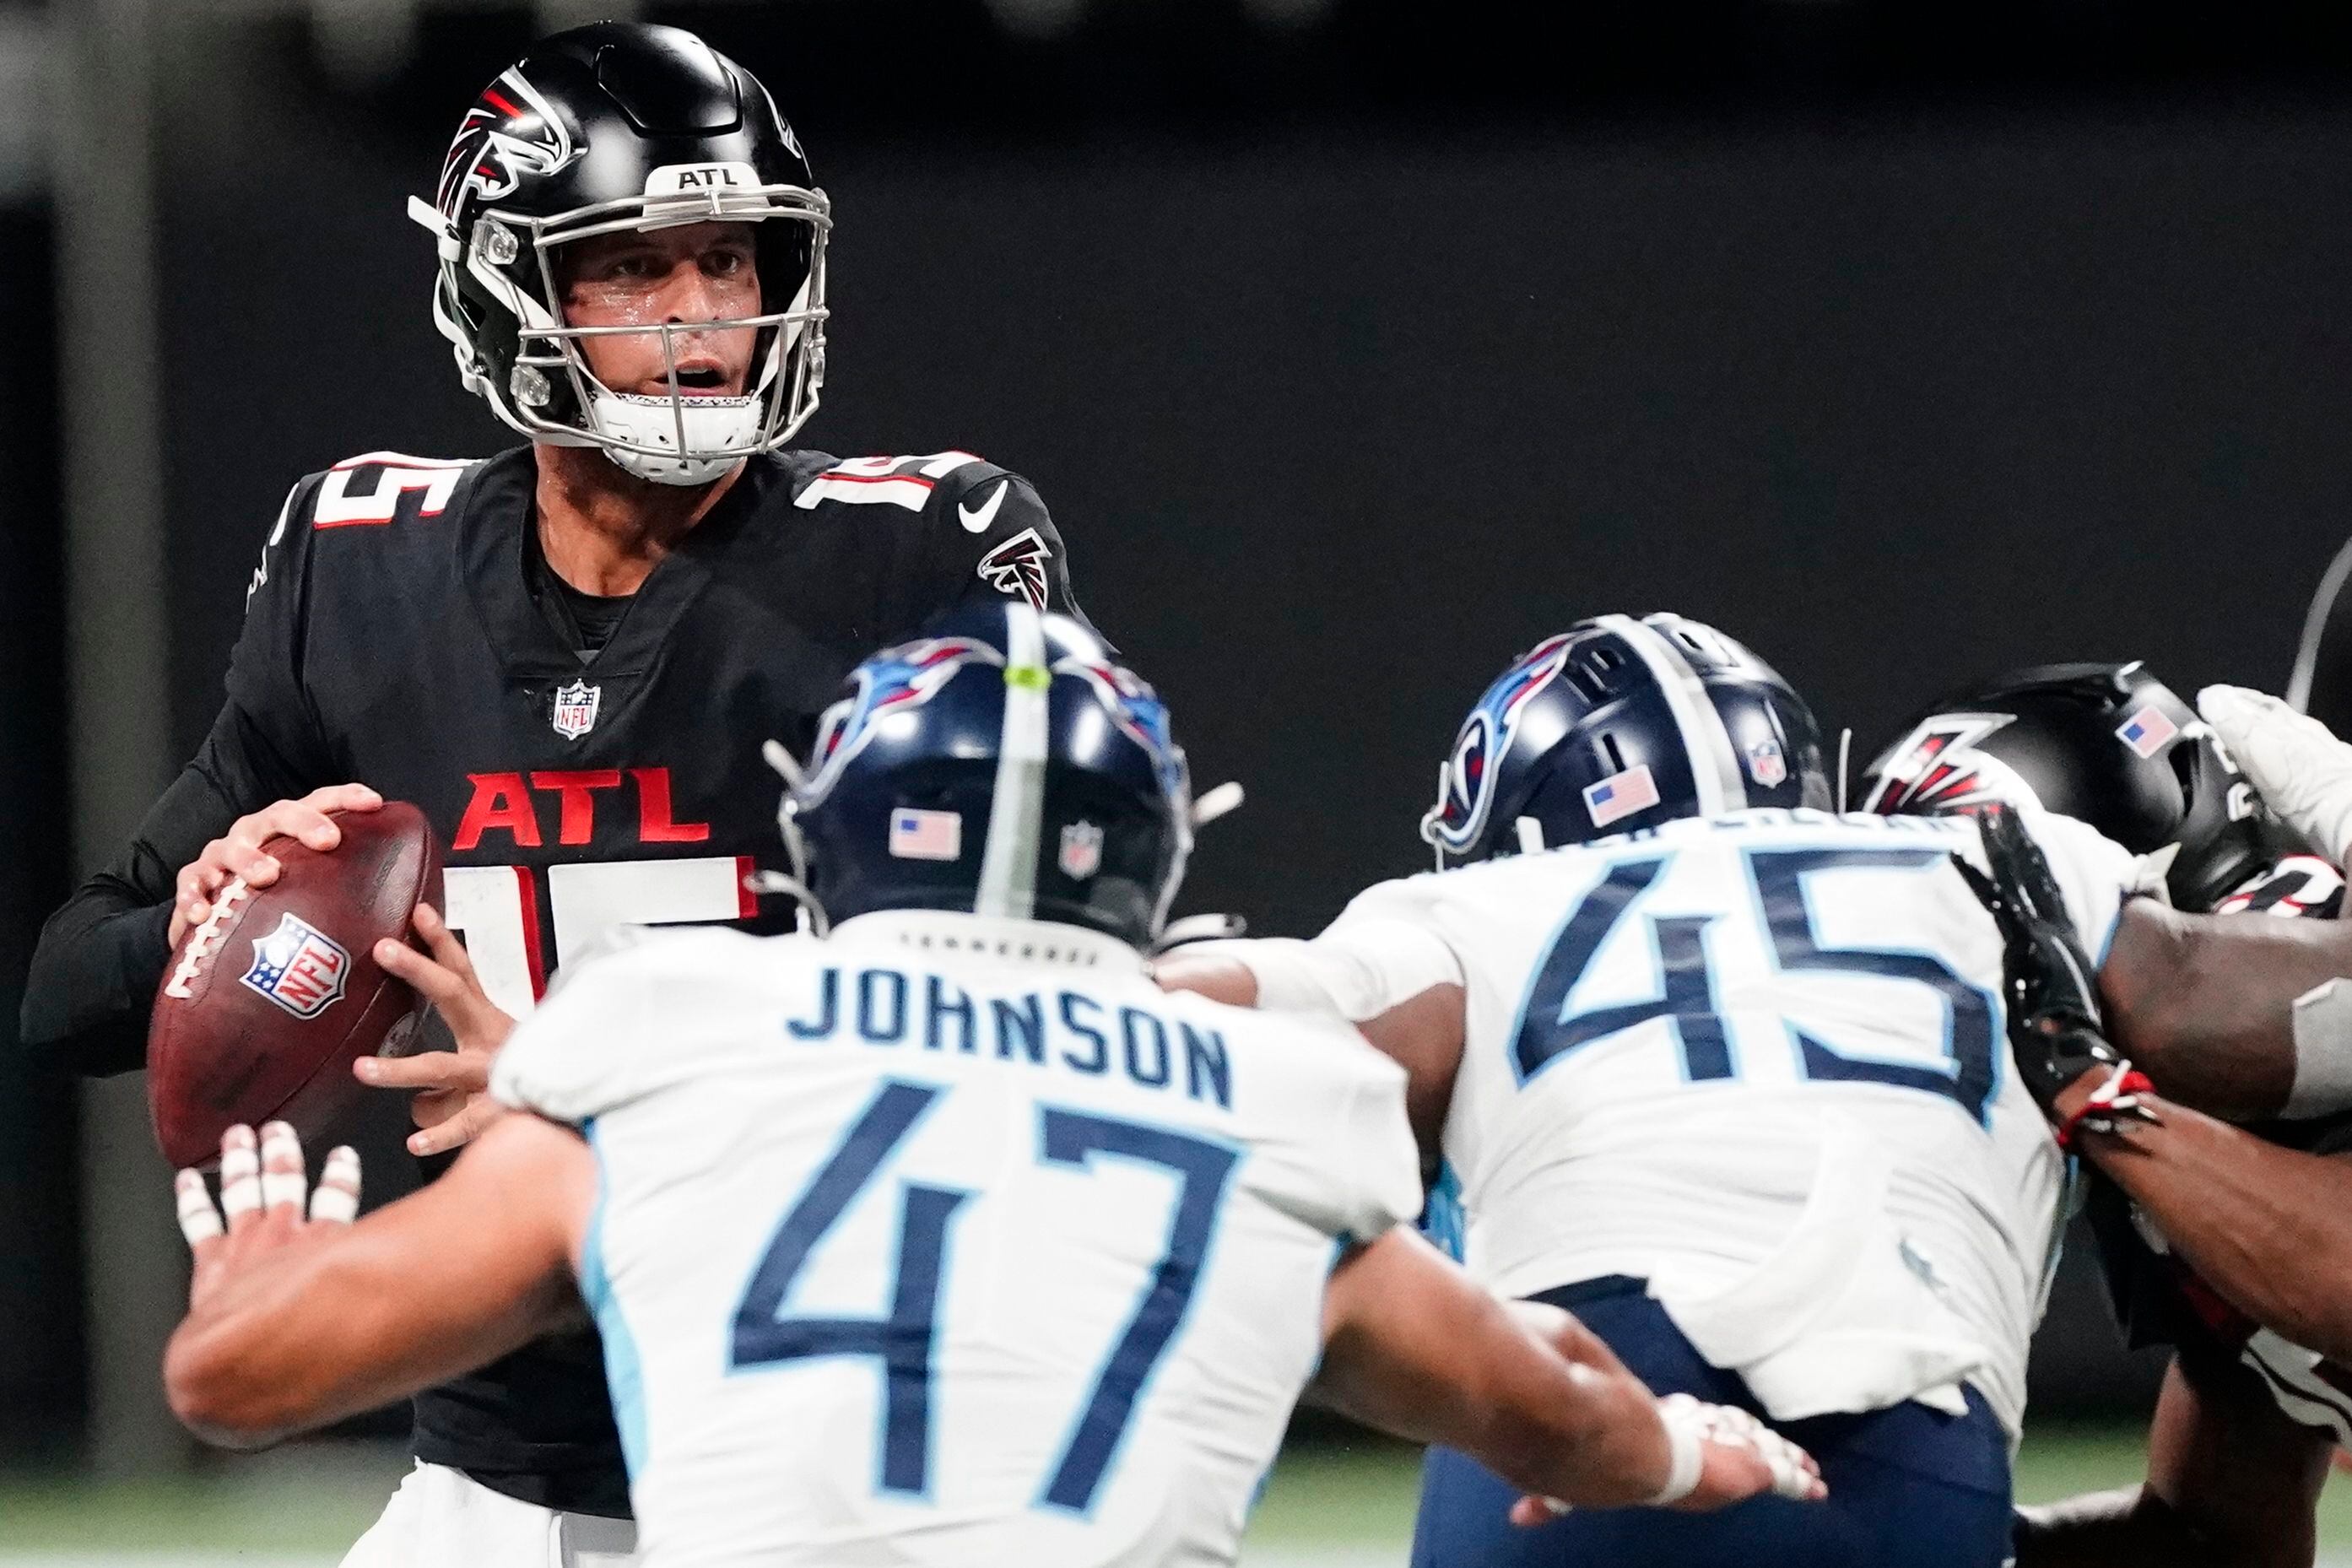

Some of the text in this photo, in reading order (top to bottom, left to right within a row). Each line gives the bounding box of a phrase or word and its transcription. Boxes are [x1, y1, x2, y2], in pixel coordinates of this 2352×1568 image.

[679, 169, 738, 189] ATL
[560, 707, 588, 729] NFL
[452, 766, 710, 850] ATL
[278, 947, 340, 1009] NFL
[1507, 846, 2003, 1134] 45
[785, 968, 1235, 1109] JOHNSON
[724, 1076, 1247, 1521] 47
